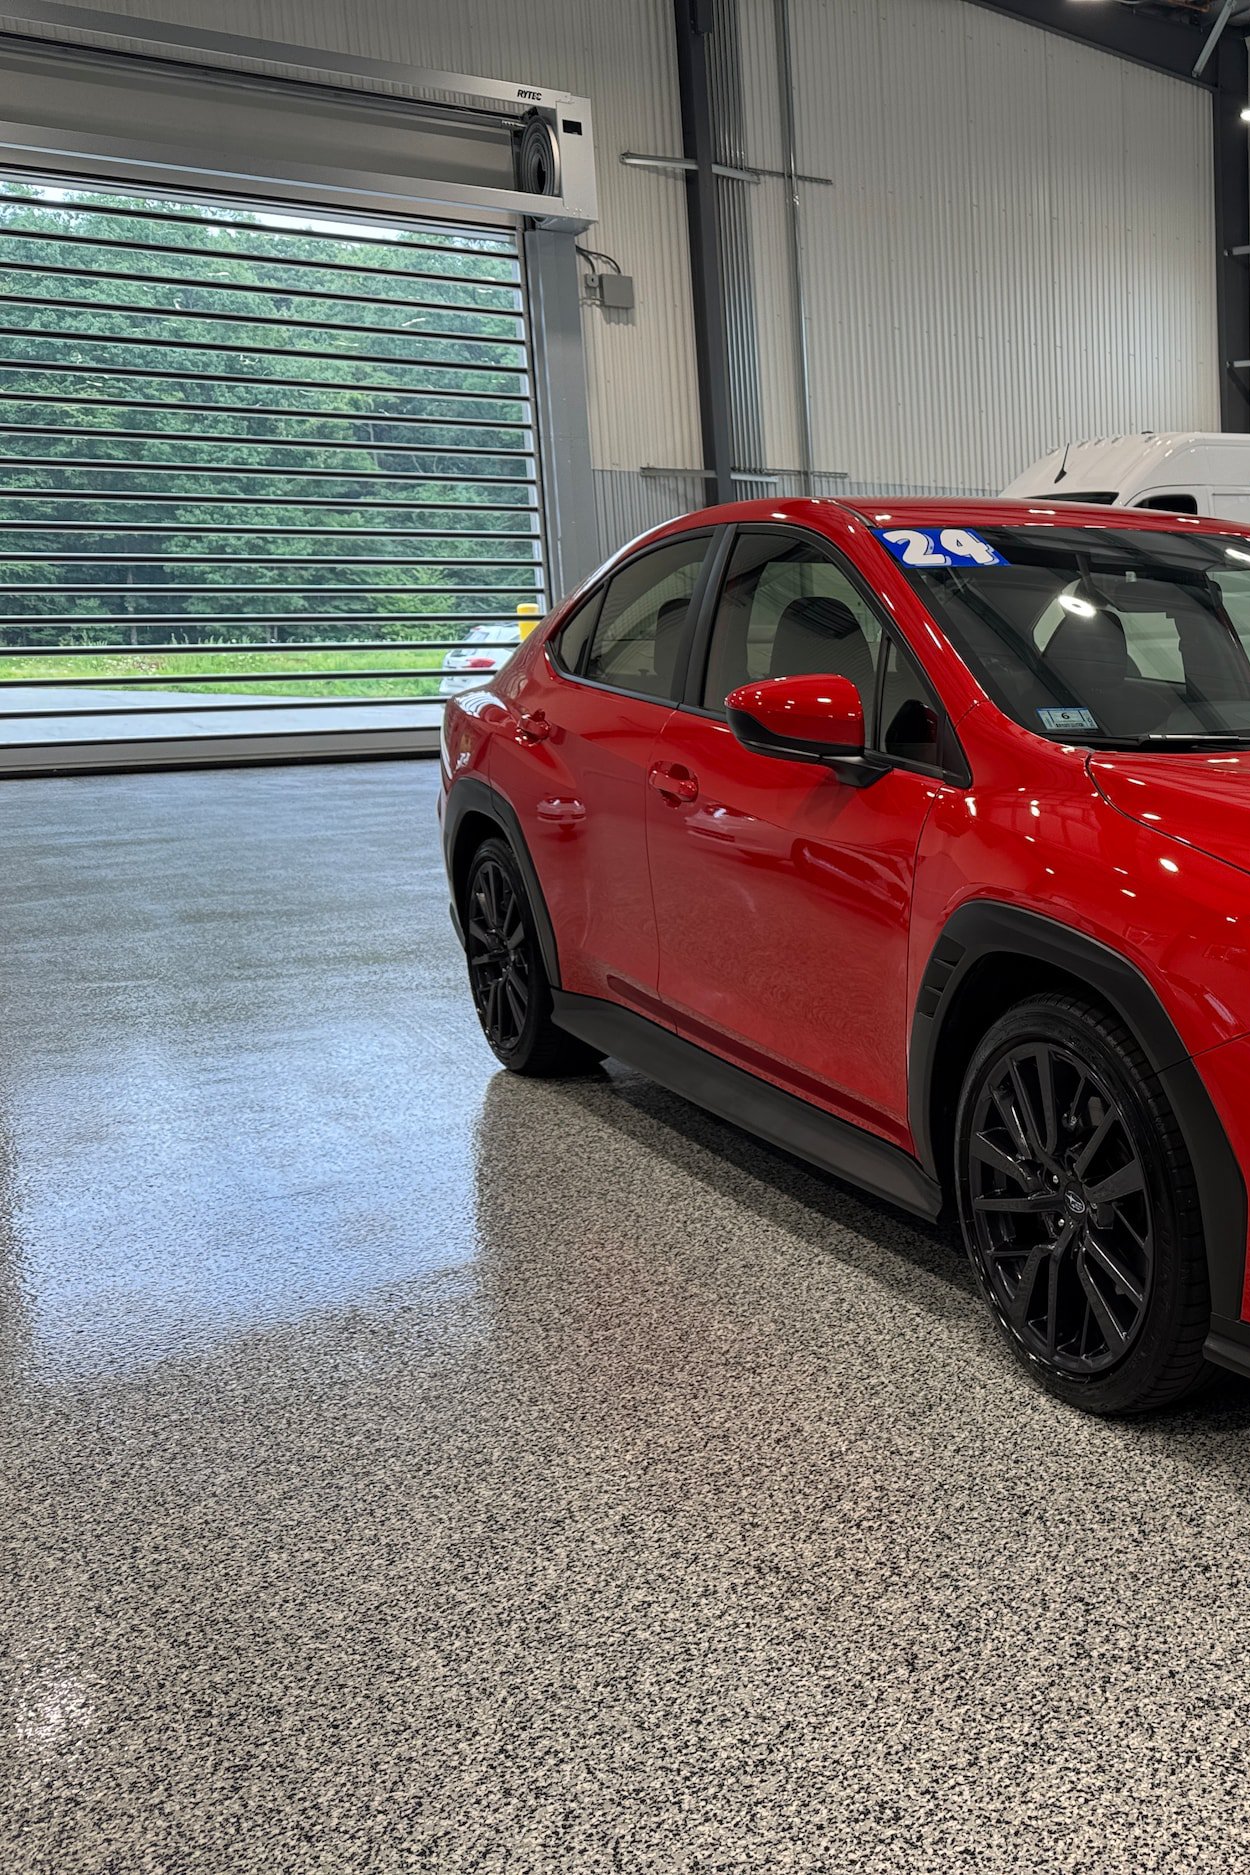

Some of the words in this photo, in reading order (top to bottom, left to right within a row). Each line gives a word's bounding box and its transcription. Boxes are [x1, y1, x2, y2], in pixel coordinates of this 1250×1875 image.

[517, 89, 542, 101] RYTEC
[883, 529, 999, 566] 24
[1061, 712, 1070, 720] 6
